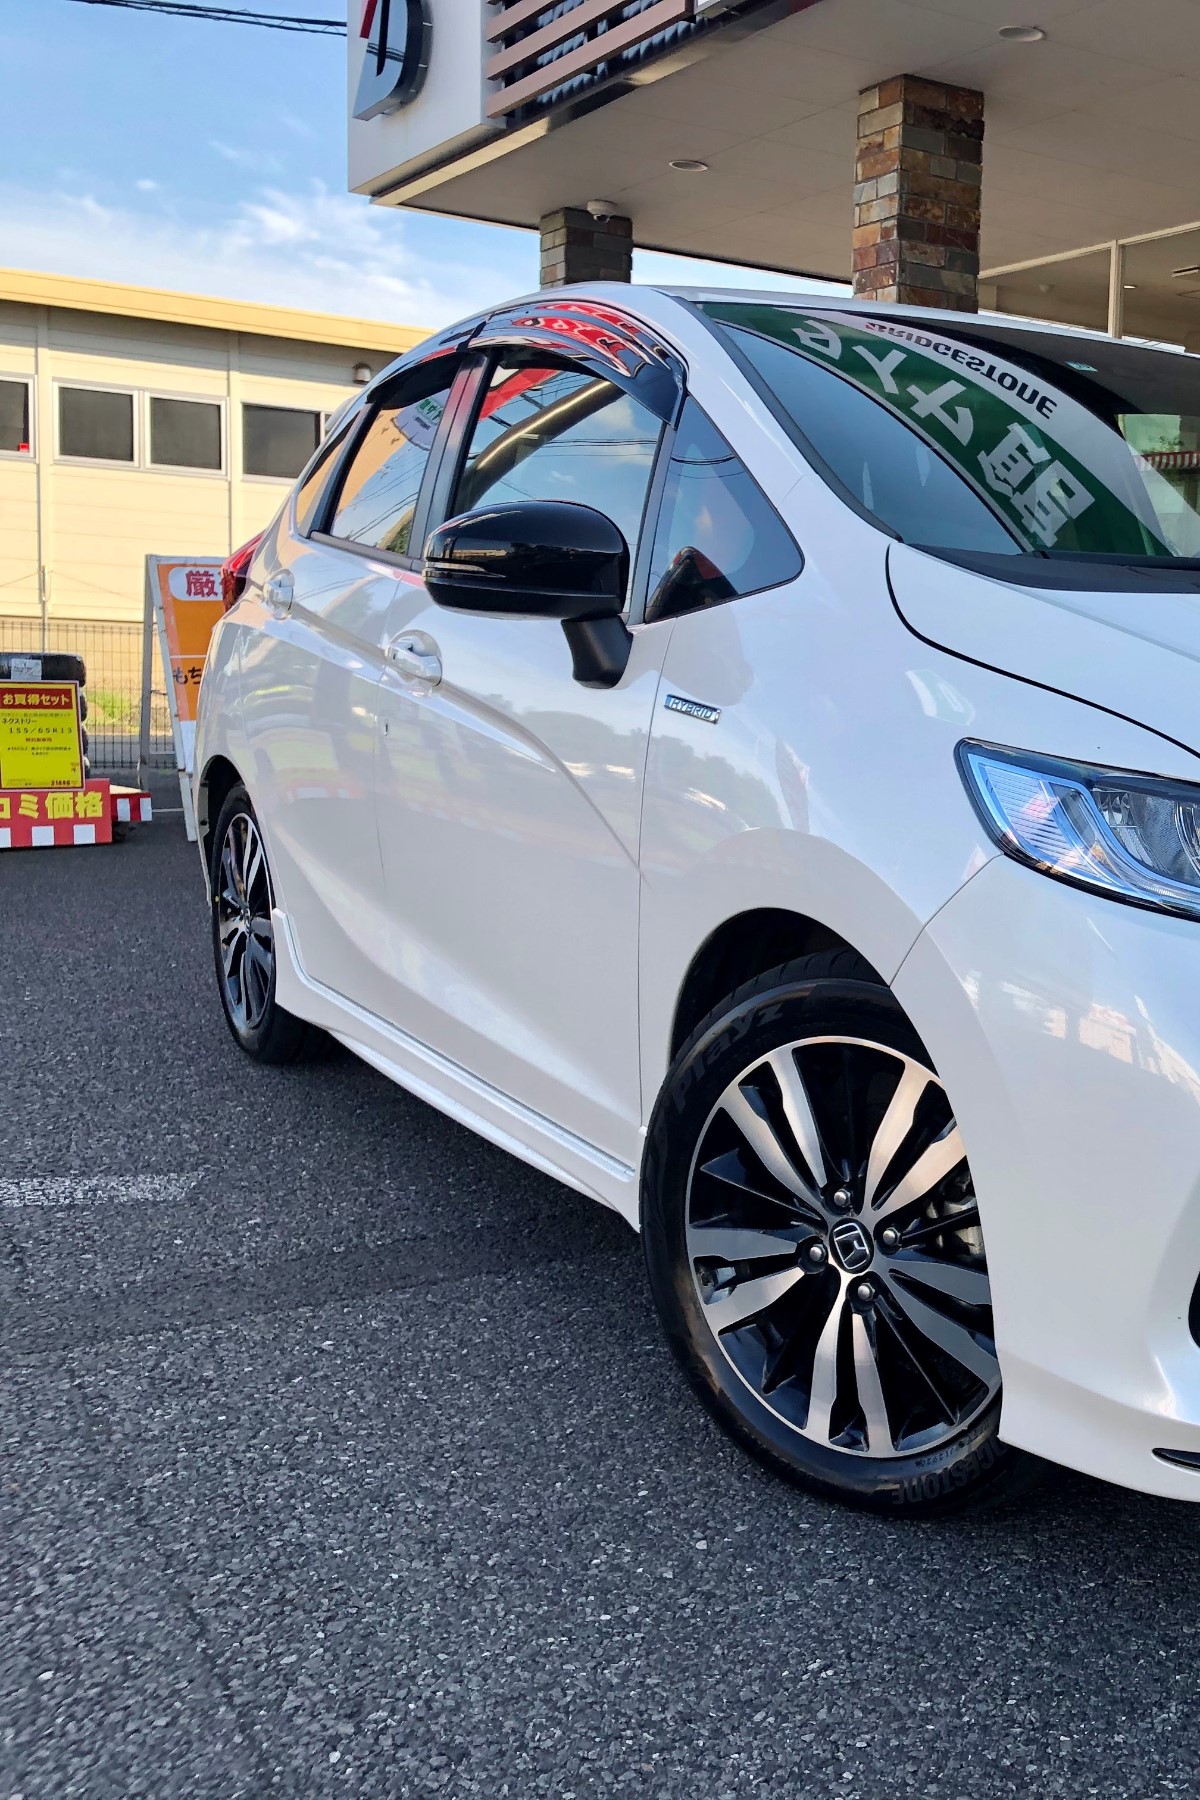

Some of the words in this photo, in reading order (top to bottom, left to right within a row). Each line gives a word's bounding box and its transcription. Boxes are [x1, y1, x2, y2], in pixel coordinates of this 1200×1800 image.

[2, 693, 70, 706] お買得セット
[668, 696, 716, 721] HYBRID
